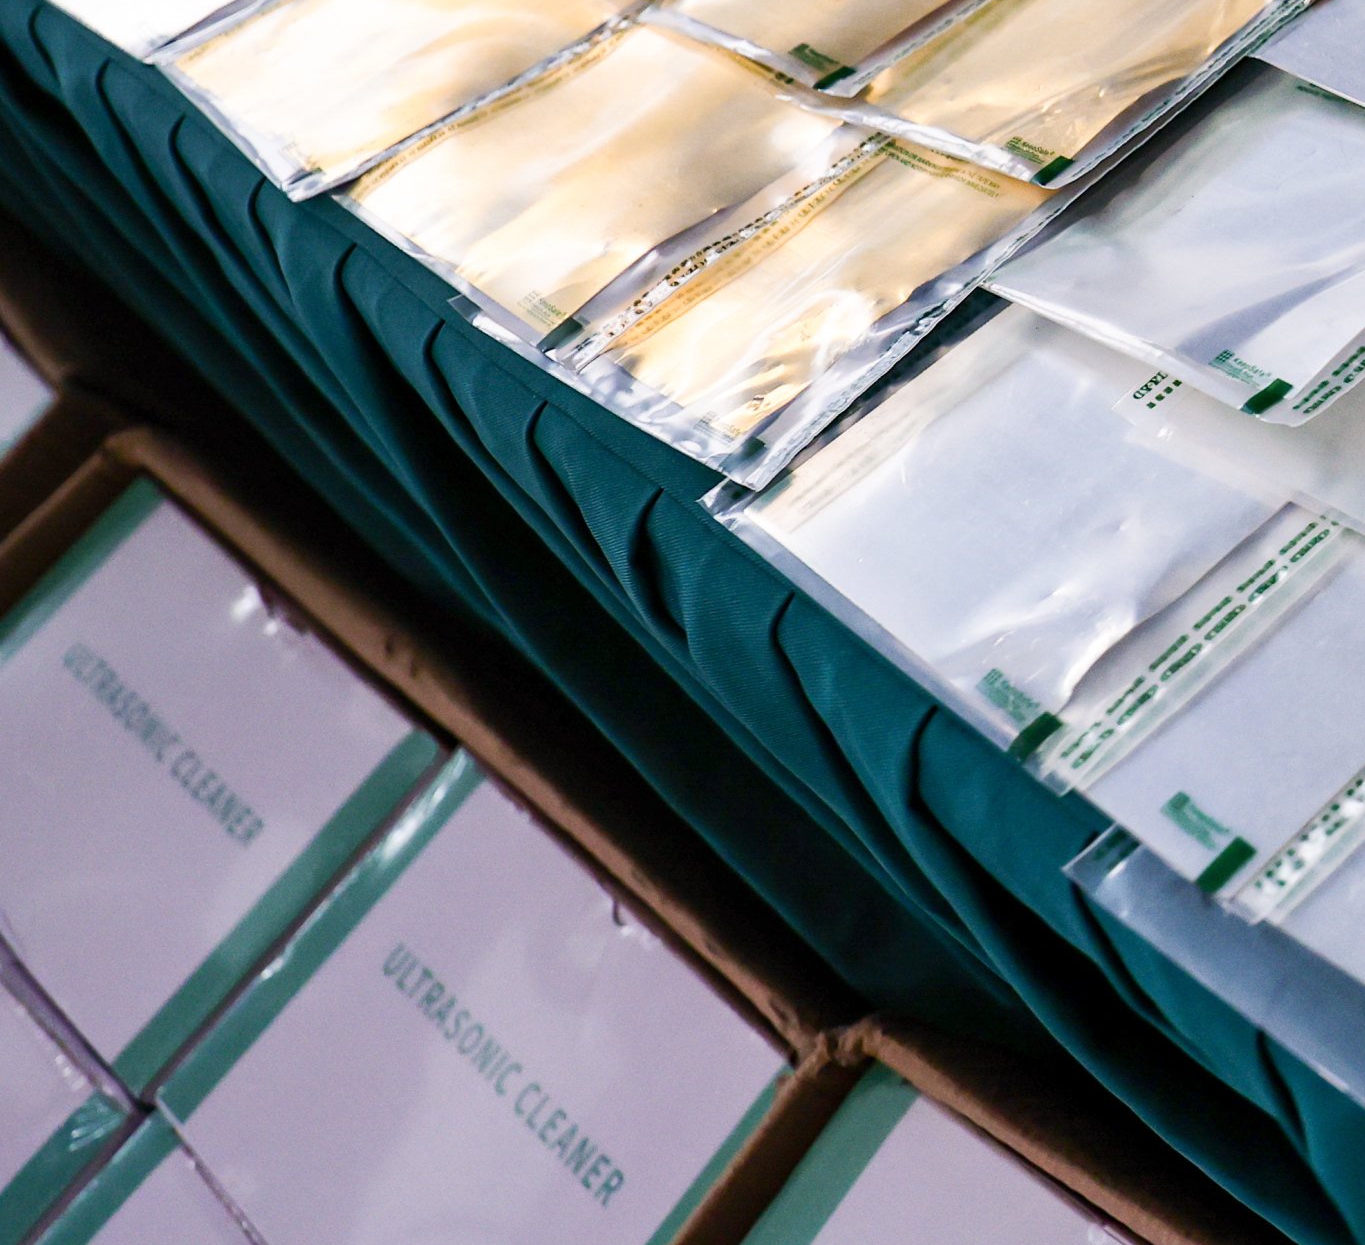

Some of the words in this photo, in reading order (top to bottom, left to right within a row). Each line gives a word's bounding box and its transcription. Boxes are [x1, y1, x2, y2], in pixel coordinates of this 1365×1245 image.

[63, 643, 182, 765] ULTRASONIC
[169, 748, 265, 846] CLEANER
[383, 942, 524, 1096] ULTRASONIC
[514, 1081, 626, 1208] CLEANER
